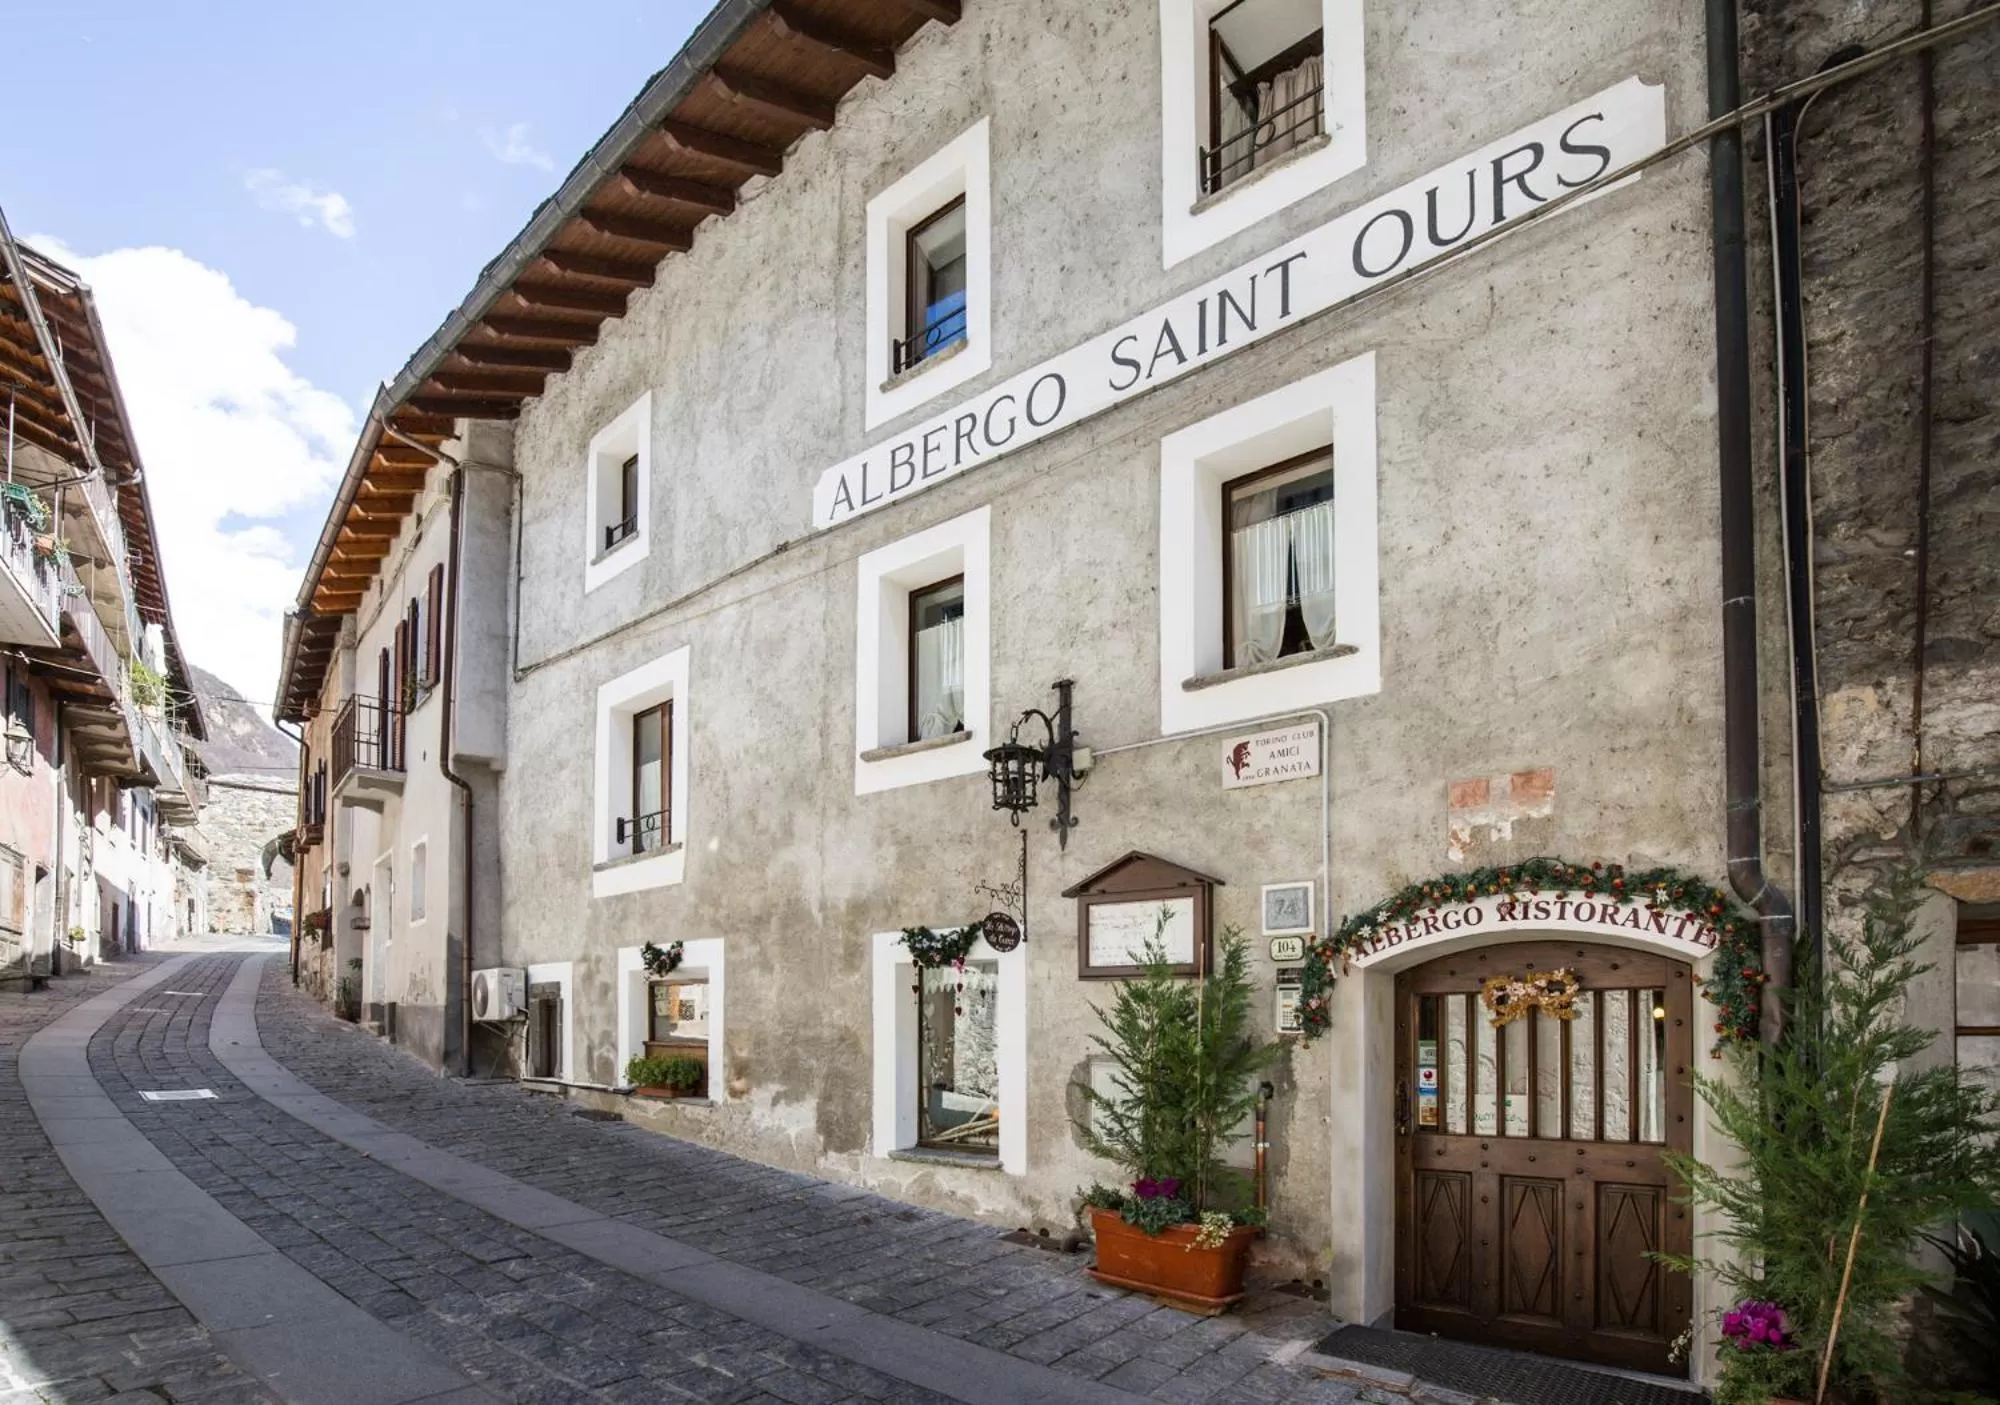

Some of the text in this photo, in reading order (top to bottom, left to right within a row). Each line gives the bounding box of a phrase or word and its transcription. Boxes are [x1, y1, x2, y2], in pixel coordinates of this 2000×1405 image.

[830, 112, 1611, 520] ALBERGO SAINT OURS
[1255, 730, 1315, 747] TORINO CLUB
[1268, 746, 1300, 760] AMICI
[1256, 761, 1312, 778] GRANATA
[1356, 899, 1716, 961] ALBERGO RISTORANTE
